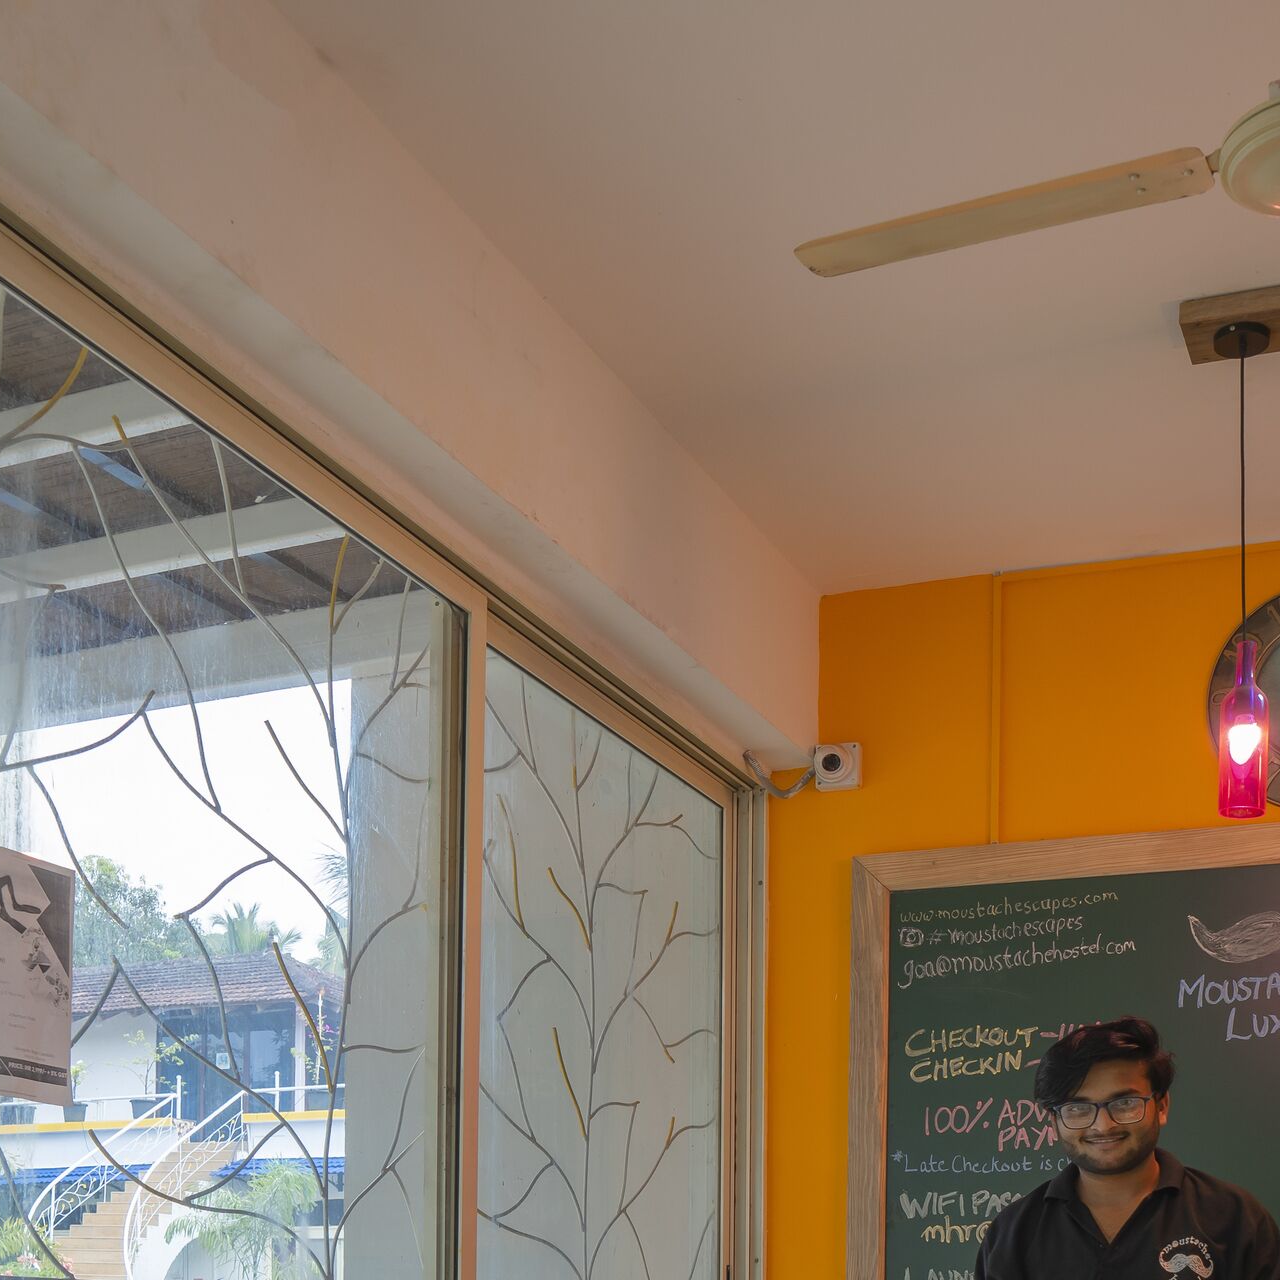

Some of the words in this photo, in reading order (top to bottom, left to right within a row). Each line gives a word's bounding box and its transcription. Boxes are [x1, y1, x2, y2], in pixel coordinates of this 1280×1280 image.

[900, 891, 1118, 922] www.moustachescapes.com
[898, 933, 1136, 989] goa@moustachehostel.com
[924, 1097, 993, 1136] 100%
[951, 1154, 1032, 1174] Checkout
[1040, 1154, 1053, 1171] is
[899, 1190, 965, 1219] WIFI
